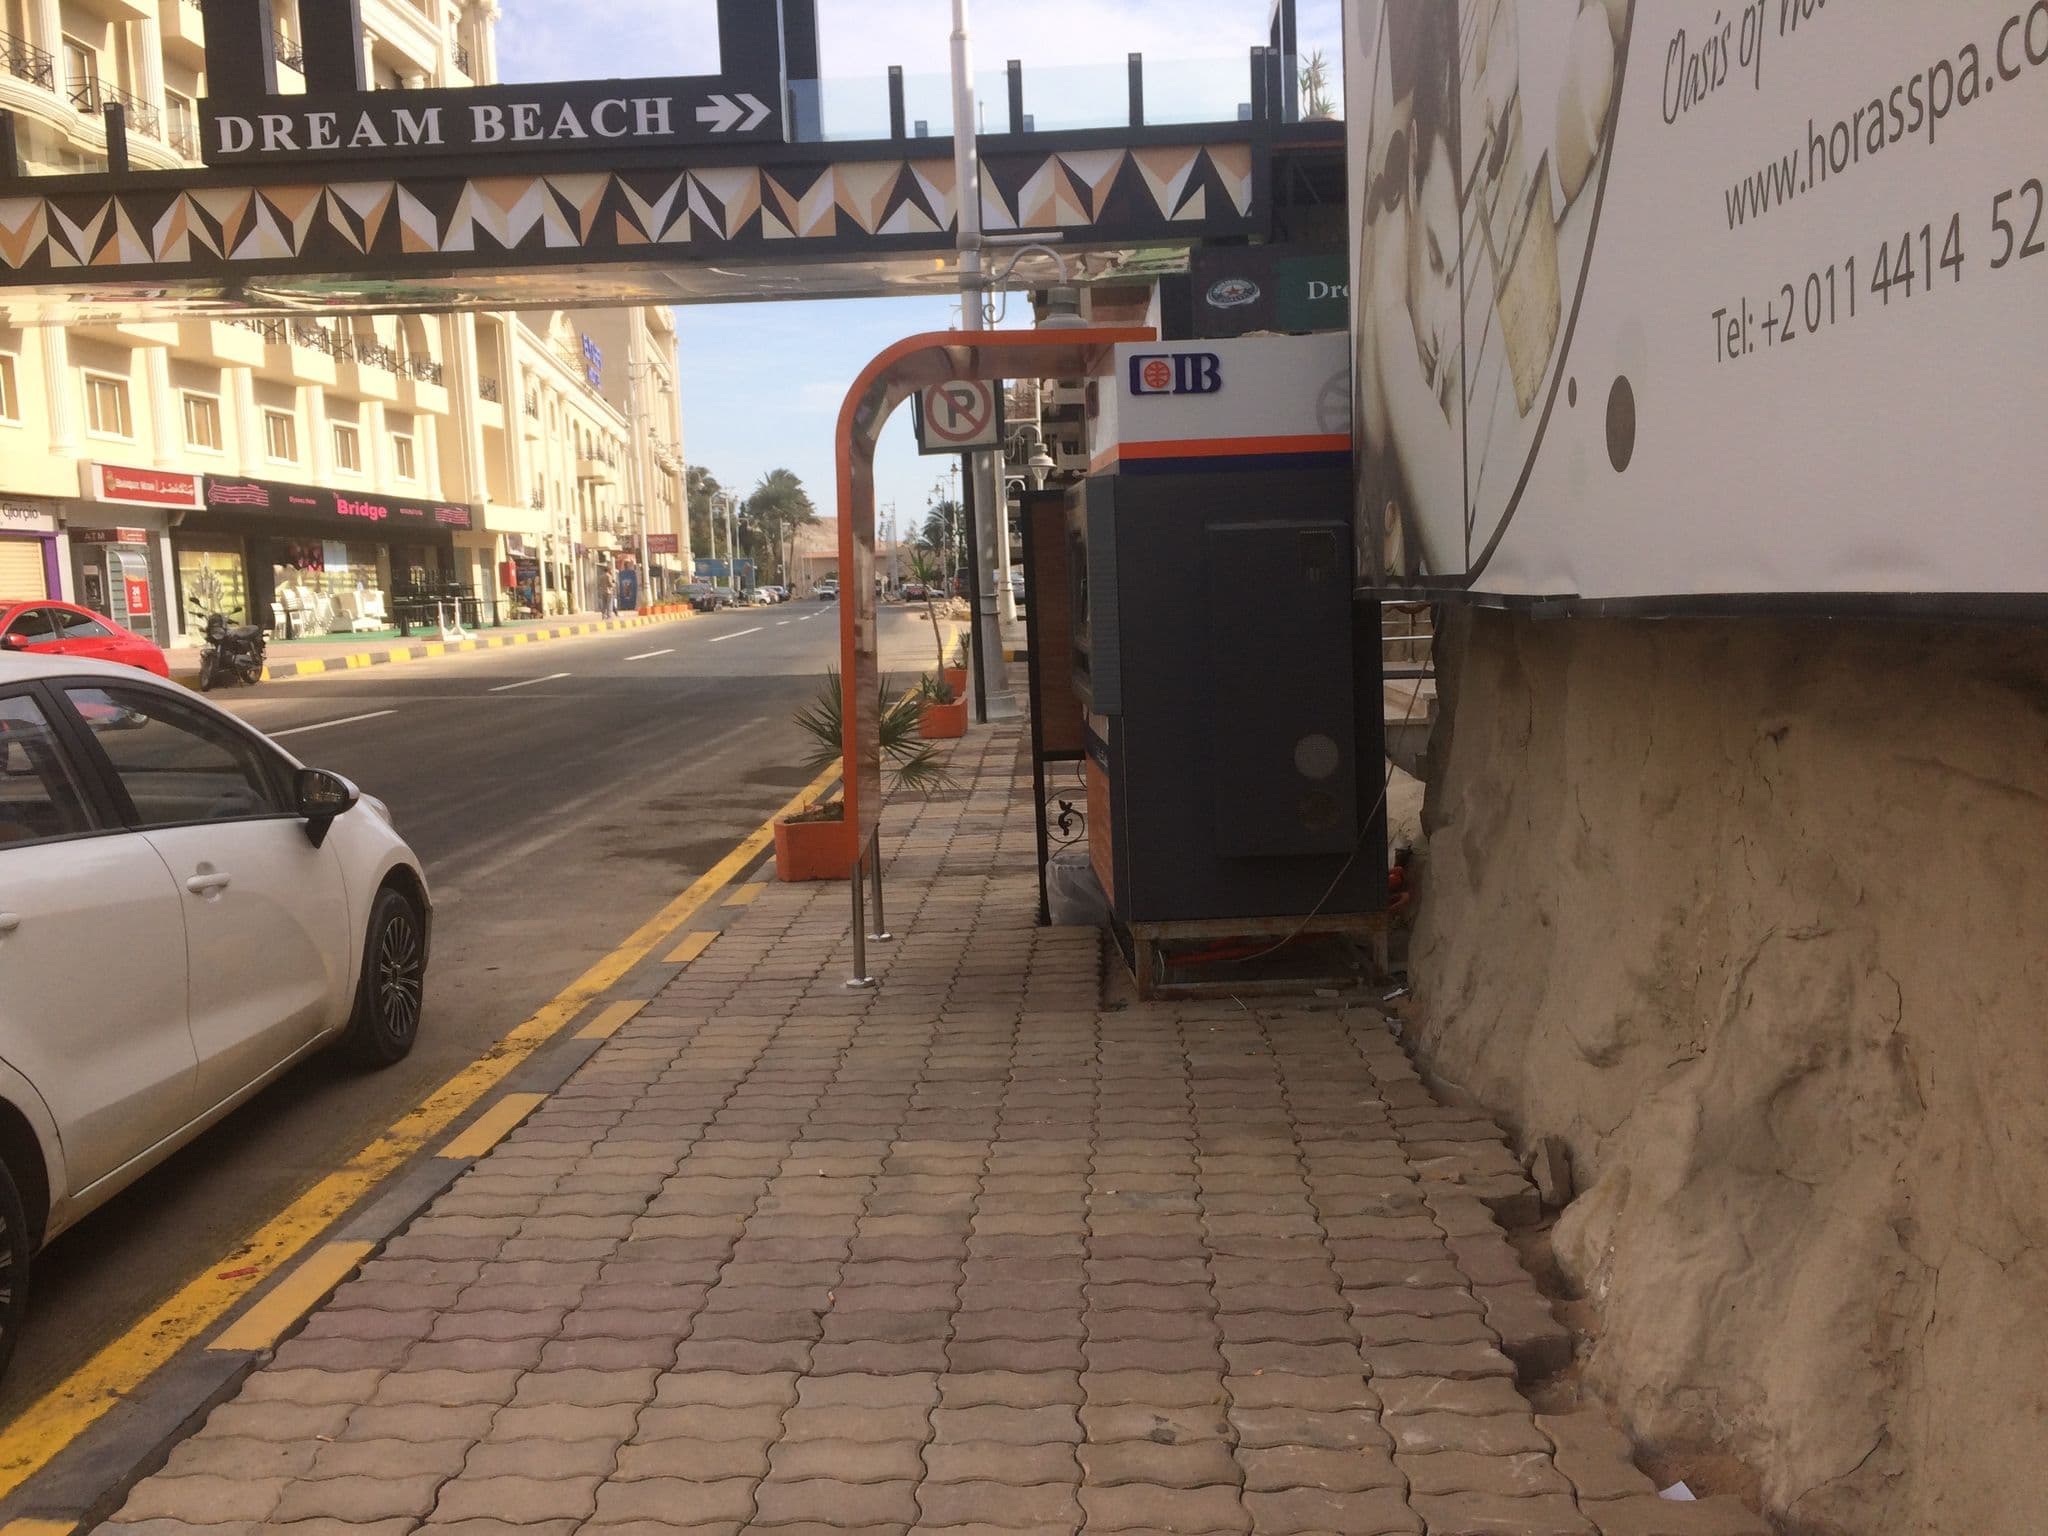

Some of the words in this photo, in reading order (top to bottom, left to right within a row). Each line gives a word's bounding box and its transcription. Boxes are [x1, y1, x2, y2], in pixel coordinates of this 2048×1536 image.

[1663, 10, 1731, 124] Oasis
[1740, 0, 1764, 90] of
[214, 107, 445, 153] DREAM
[469, 97, 675, 143] BEACH
[1712, 297, 1754, 362] Tel:
[1870, 212, 1964, 305] 4414
[1990, 177, 2045, 269] 52
[1129, 352, 1222, 396] CIB
[336, 499, 388, 521] Bridge
[84, 531, 105, 541] ATM
